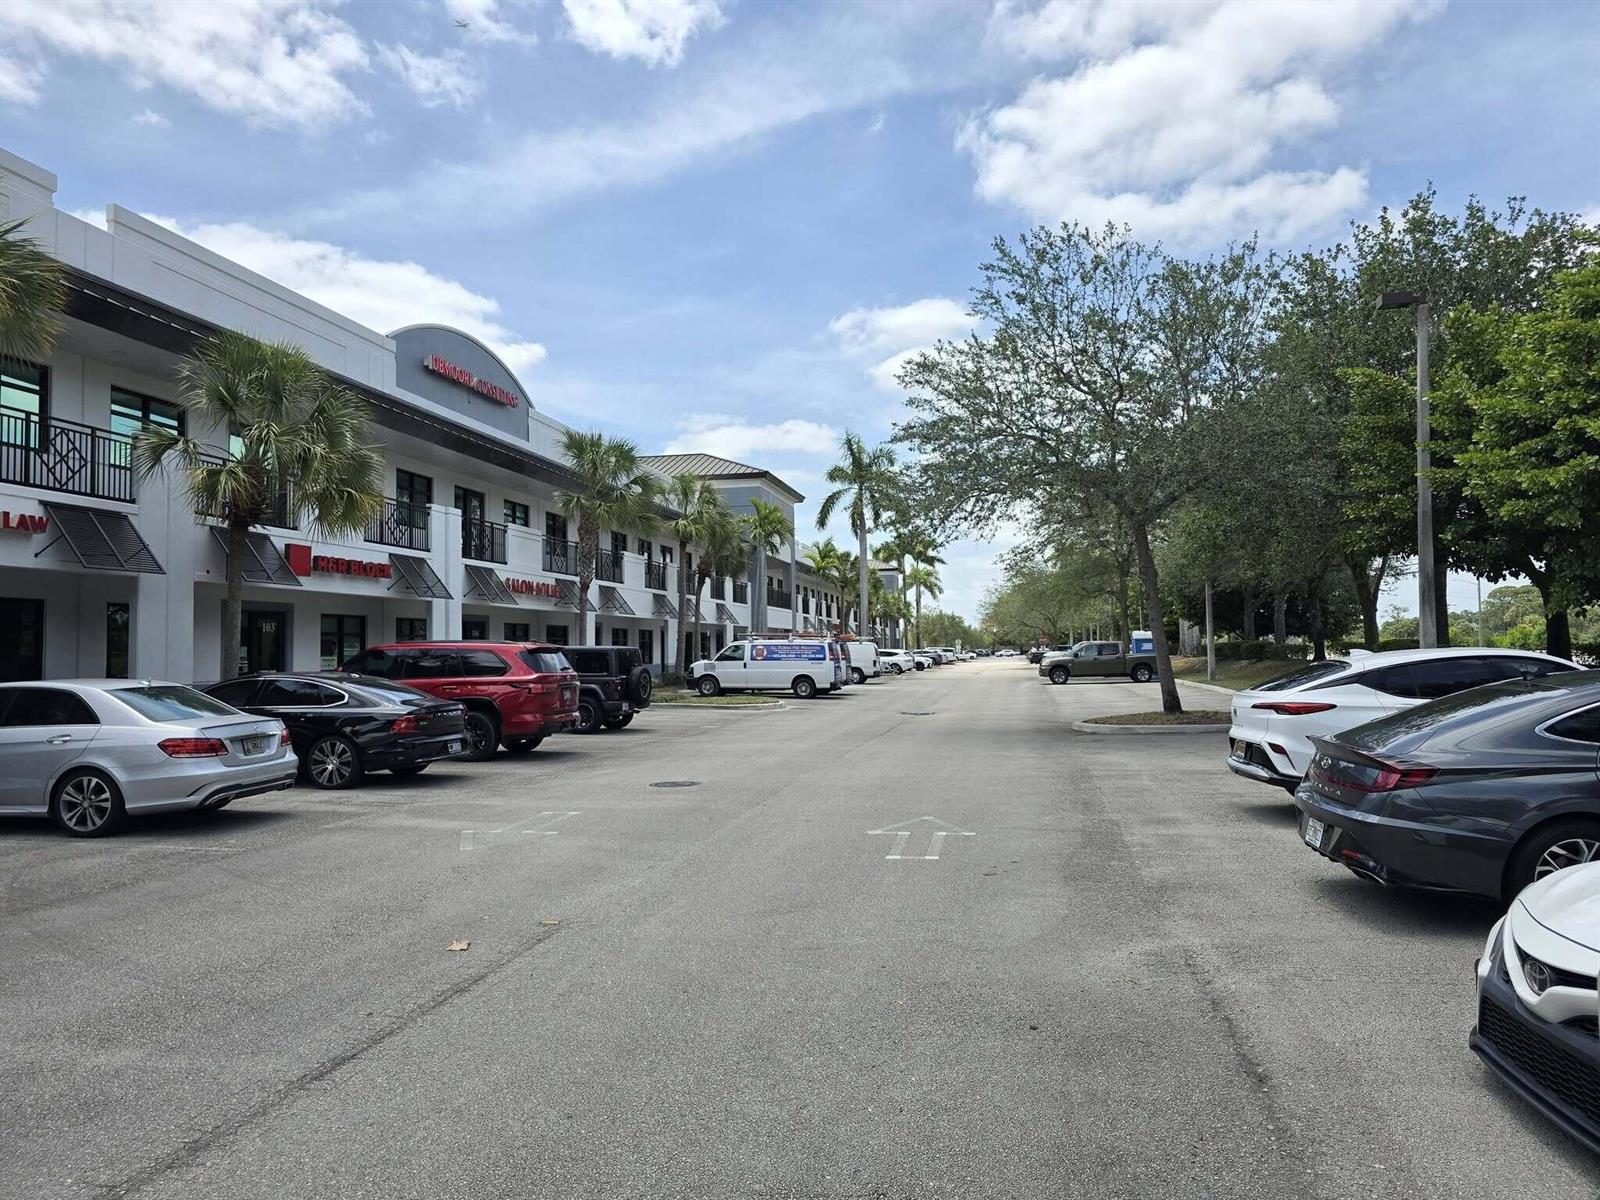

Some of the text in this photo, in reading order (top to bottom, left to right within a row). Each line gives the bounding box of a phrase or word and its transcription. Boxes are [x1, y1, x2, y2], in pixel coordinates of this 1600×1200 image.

[0, 510, 49, 534] LAW
[313, 555, 393, 579] H&R BLOCK
[262, 622, 276, 633] 103
